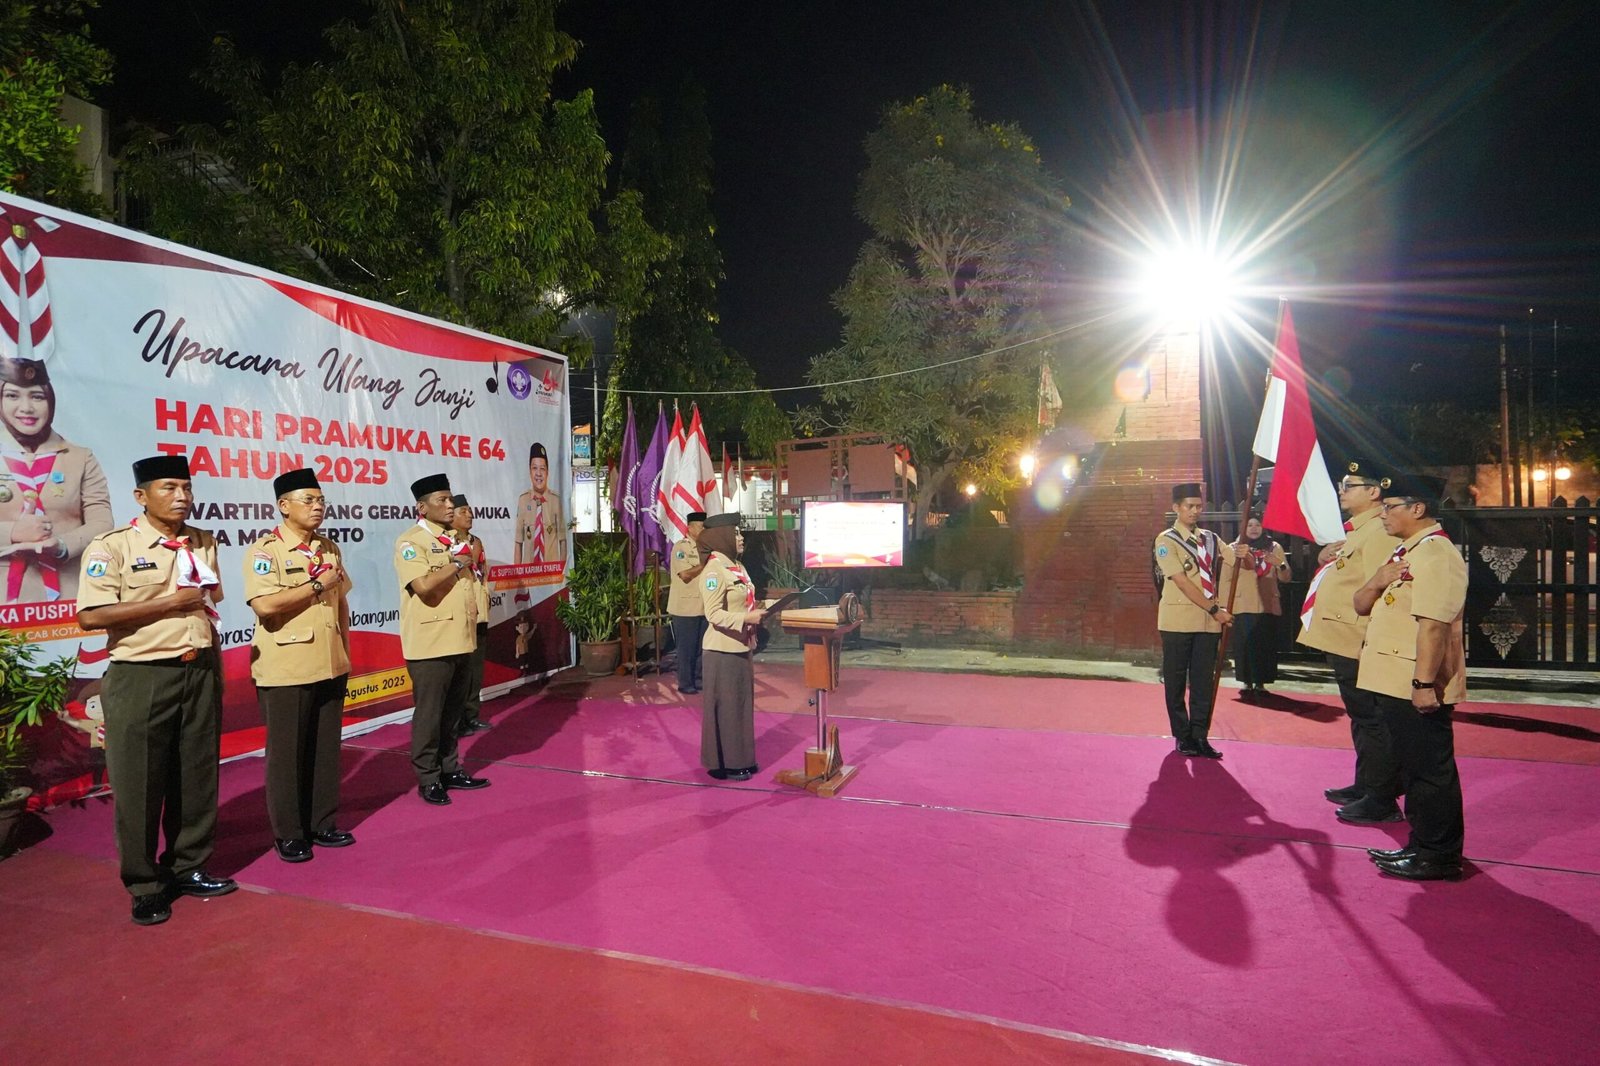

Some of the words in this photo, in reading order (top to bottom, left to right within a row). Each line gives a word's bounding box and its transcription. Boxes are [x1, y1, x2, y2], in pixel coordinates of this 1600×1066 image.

[133, 309, 306, 378] Upacara
[317, 347, 405, 411] Ulang
[414, 368, 475, 420] Janji
[155, 398, 262, 440] HARI
[275, 412, 434, 455] PRAMUKA
[441, 433, 472, 459] KE
[478, 437, 506, 461] 64
[157, 442, 304, 480] TAHUN
[314, 454, 388, 486] 2025
[186, 502, 275, 520] WARTIR
[323, 504, 363, 520] ANG
[367, 505, 420, 520] GERAK
[468, 506, 511, 520] AMUKA
[349, 609, 400, 628] bangun
[51, 626, 81, 638] KOTA
[345, 684, 379, 699] Agustus
[382, 675, 405, 690] 2025
